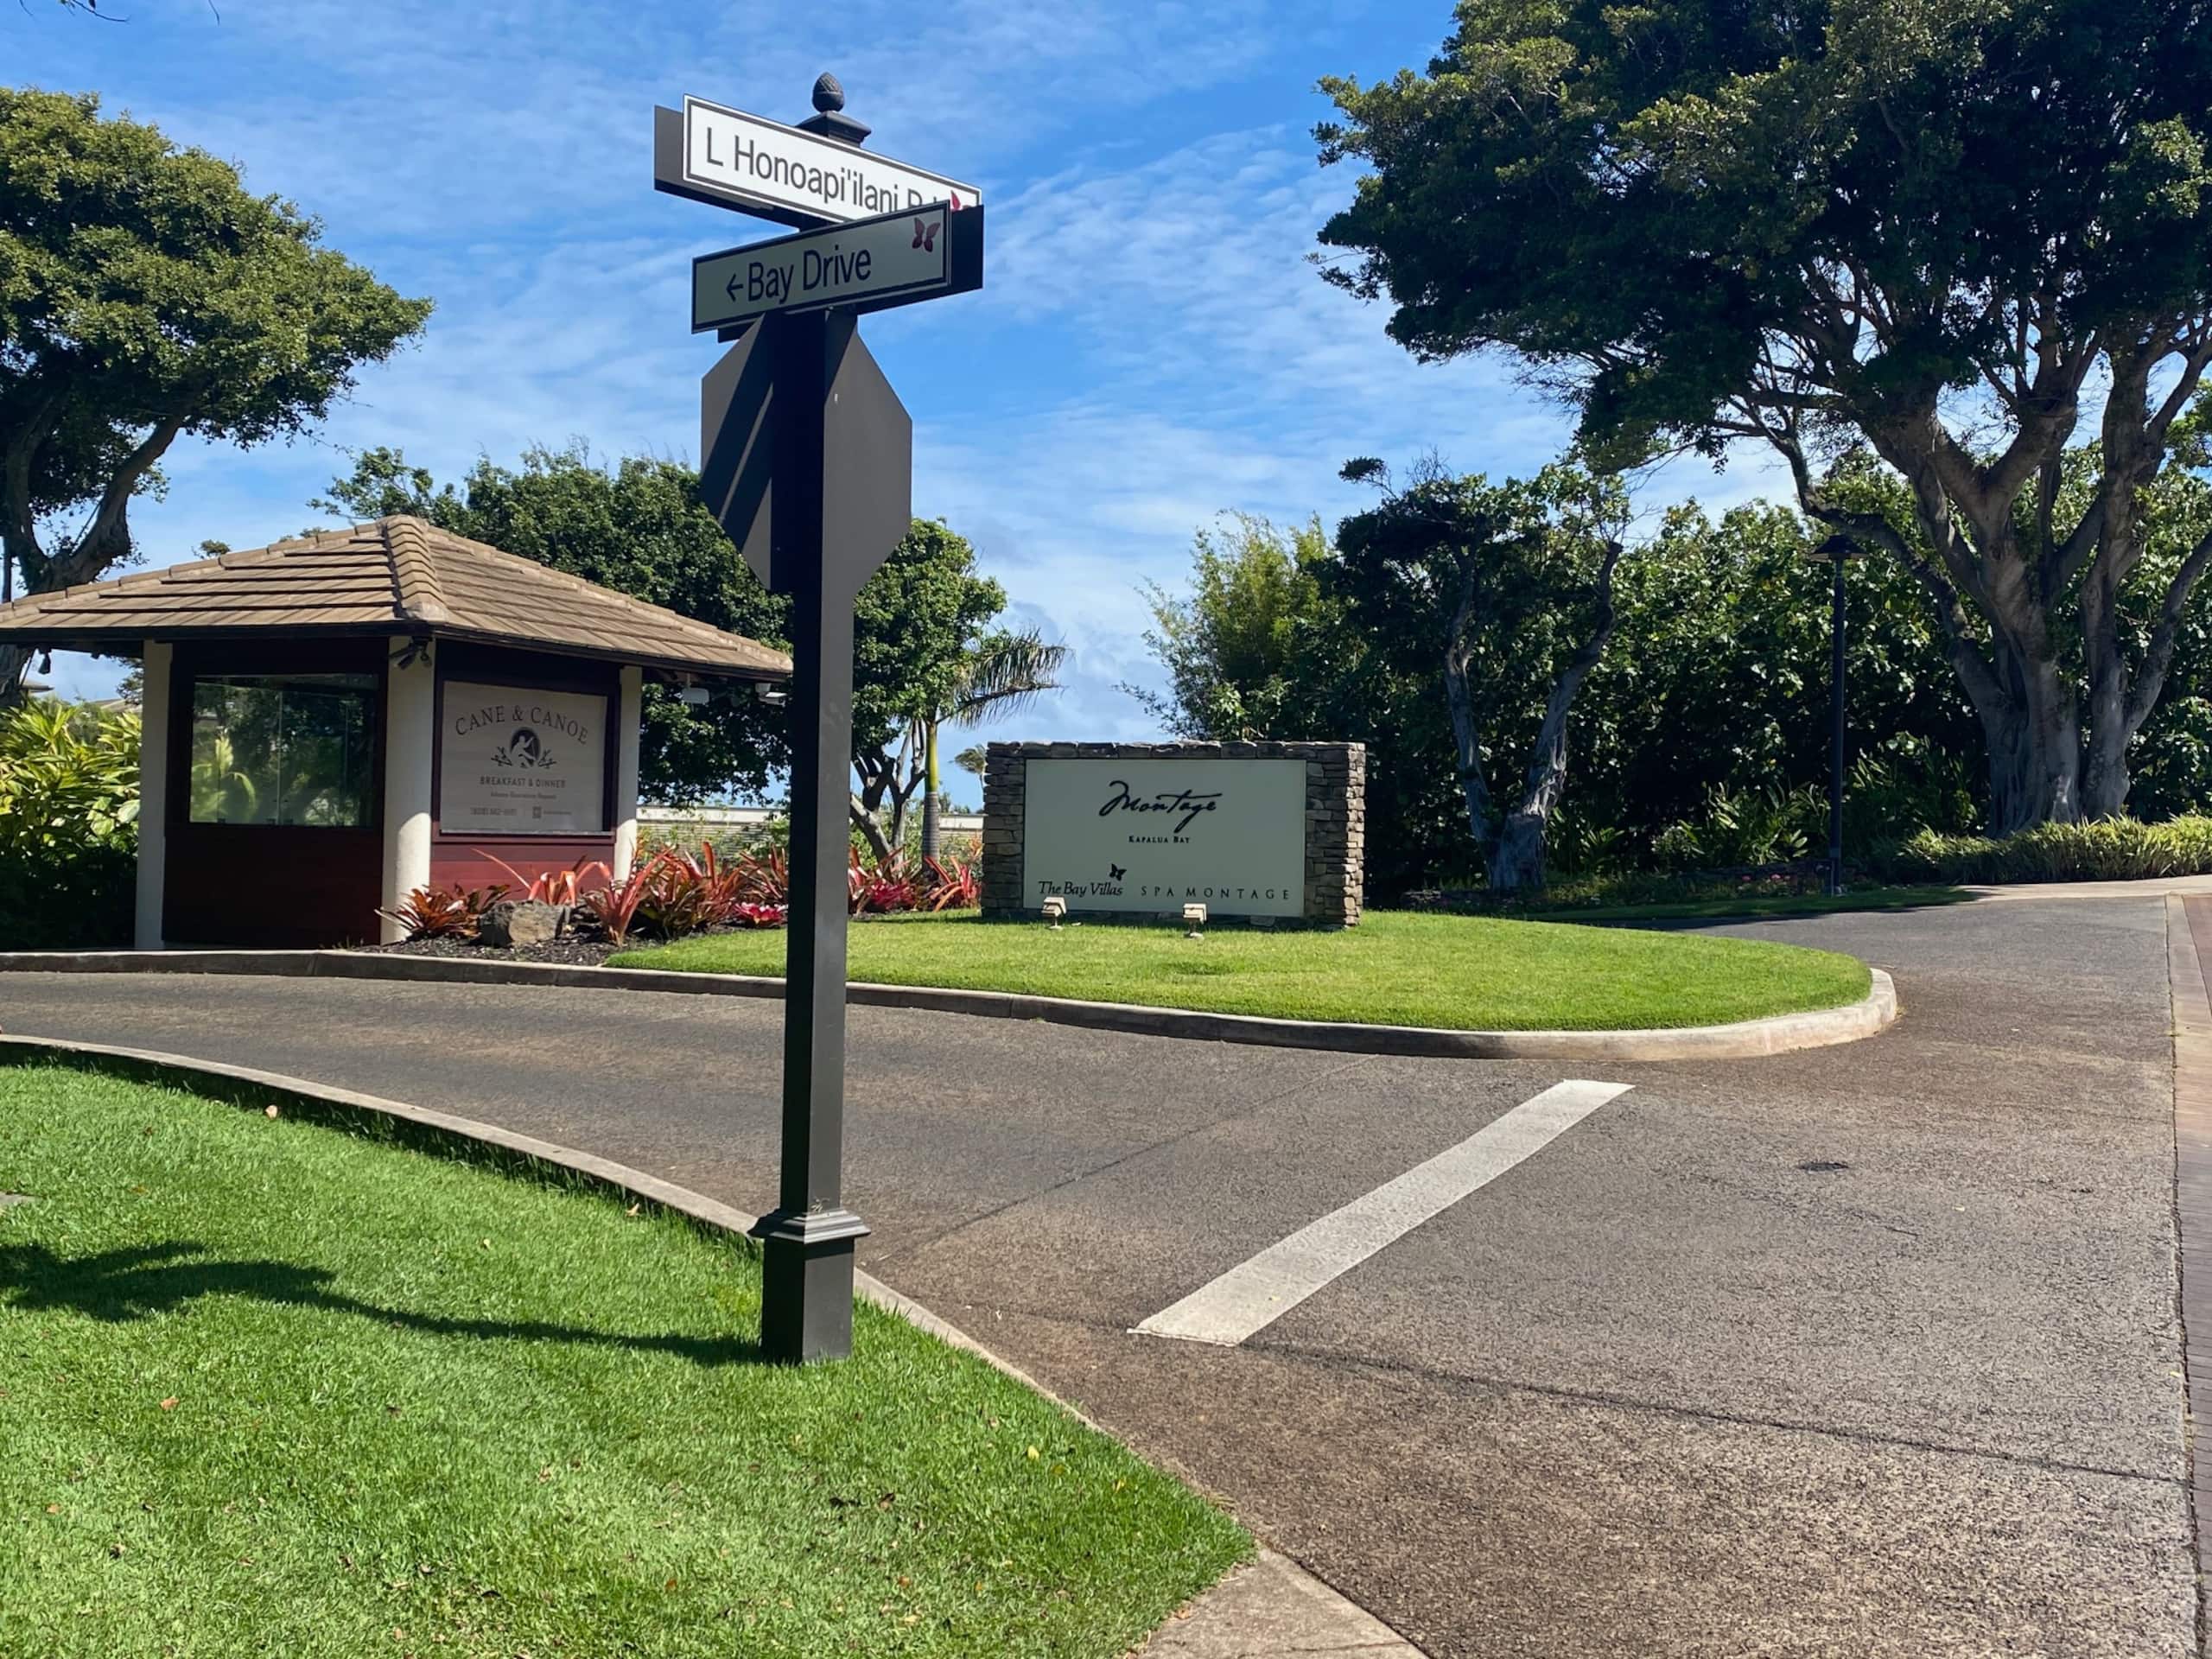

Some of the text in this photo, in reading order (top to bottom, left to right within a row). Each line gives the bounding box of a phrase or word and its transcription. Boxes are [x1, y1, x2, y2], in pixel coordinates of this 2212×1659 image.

[706, 126, 937, 213] L Honoapi'ilani R
[747, 245, 872, 305] Bay Drive
[455, 705, 588, 745] CANE & CANOE
[480, 776, 525, 786] BREAKFAST
[536, 779, 566, 788] DINNER
[1098, 780, 1223, 834] Montage
[1038, 880, 1123, 898] The Bay Villas
[1141, 886, 1290, 900] SPA MONTAGE
